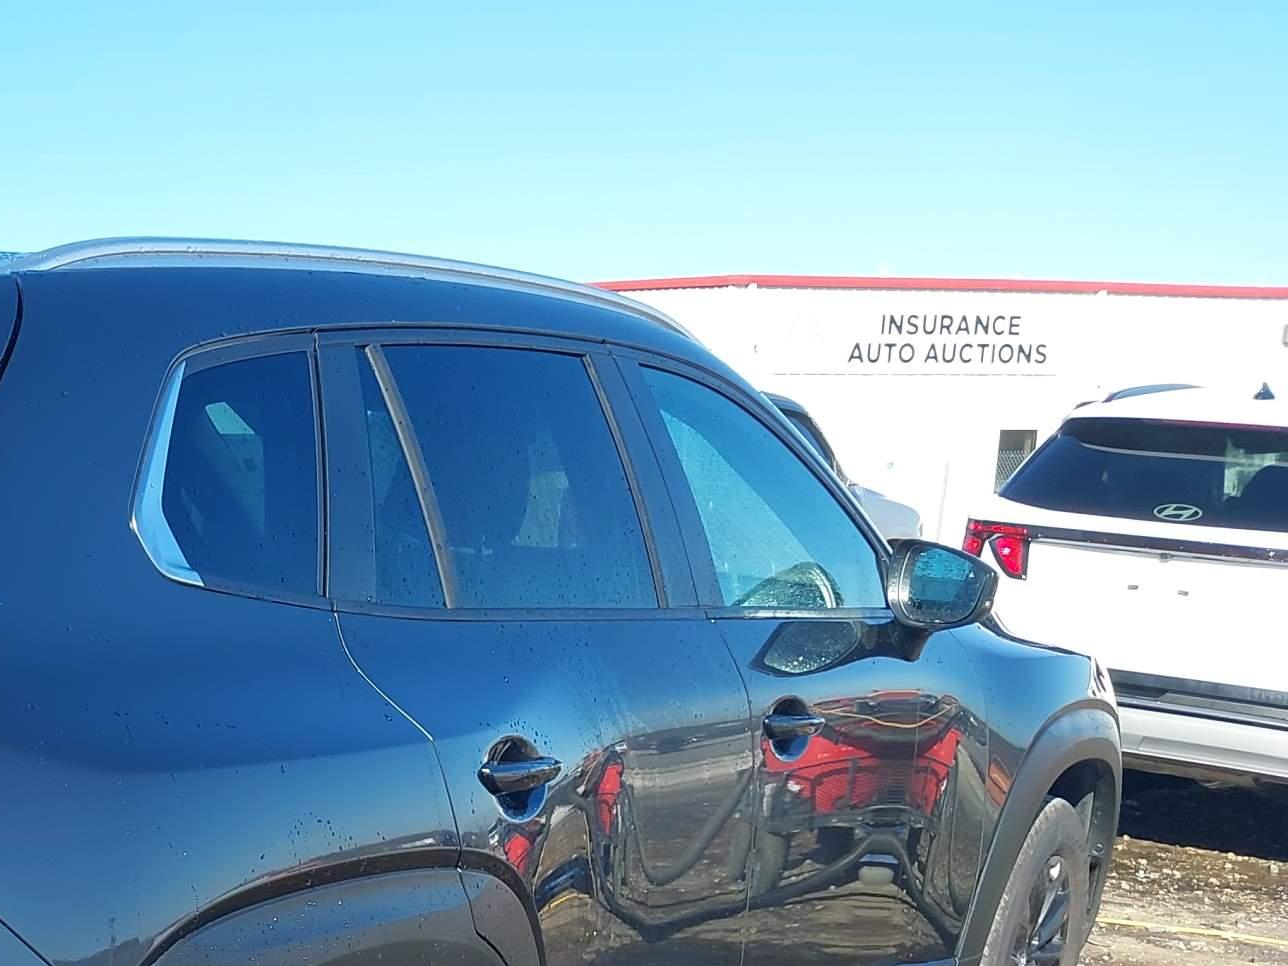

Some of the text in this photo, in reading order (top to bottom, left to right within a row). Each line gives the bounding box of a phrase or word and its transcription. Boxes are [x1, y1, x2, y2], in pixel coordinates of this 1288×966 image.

[881, 314, 1022, 335] INSURANCE
[848, 342, 1047, 364] AUTO AUCTIONS
